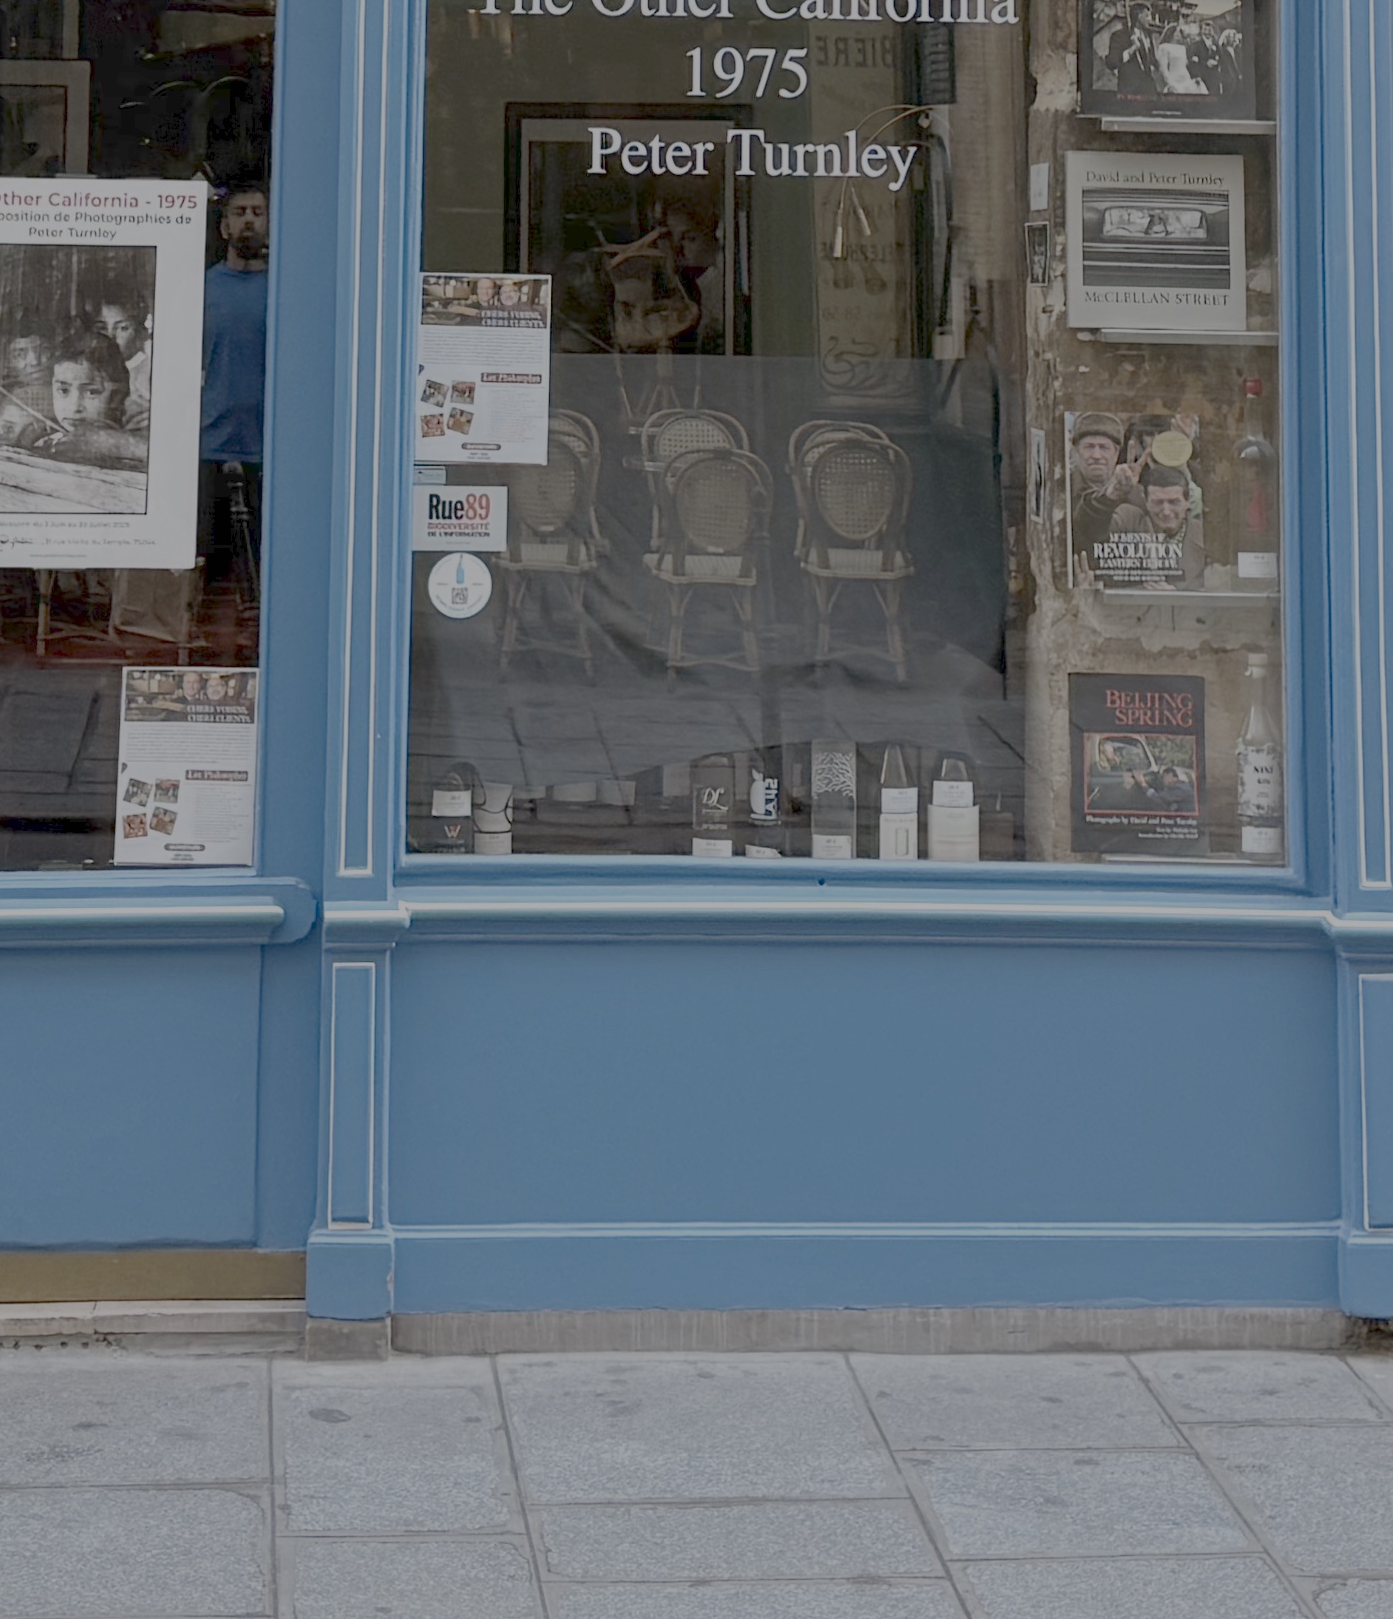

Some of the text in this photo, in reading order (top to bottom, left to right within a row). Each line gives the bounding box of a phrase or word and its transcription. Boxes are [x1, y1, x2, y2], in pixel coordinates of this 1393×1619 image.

[685, 46, 809, 99] 1975
[587, 126, 918, 192] Peter Turnley
[1086, 170, 1225, 188] David and Peter Turnley
[48, 192, 140, 209] California
[156, 194, 198, 210] 1975
[53, 211, 71, 223] de
[74, 212, 172, 226] Photographies
[175, 214, 192, 225] de
[28, 226, 117, 241] Peter Turnley
[1174, 292, 1231, 306] STREET
[428, 493, 491, 521] Rue89
[1093, 542, 1183, 559] REVOLUTION
[1105, 689, 1193, 710] BEIJING
[1115, 708, 1193, 728] SPRING
